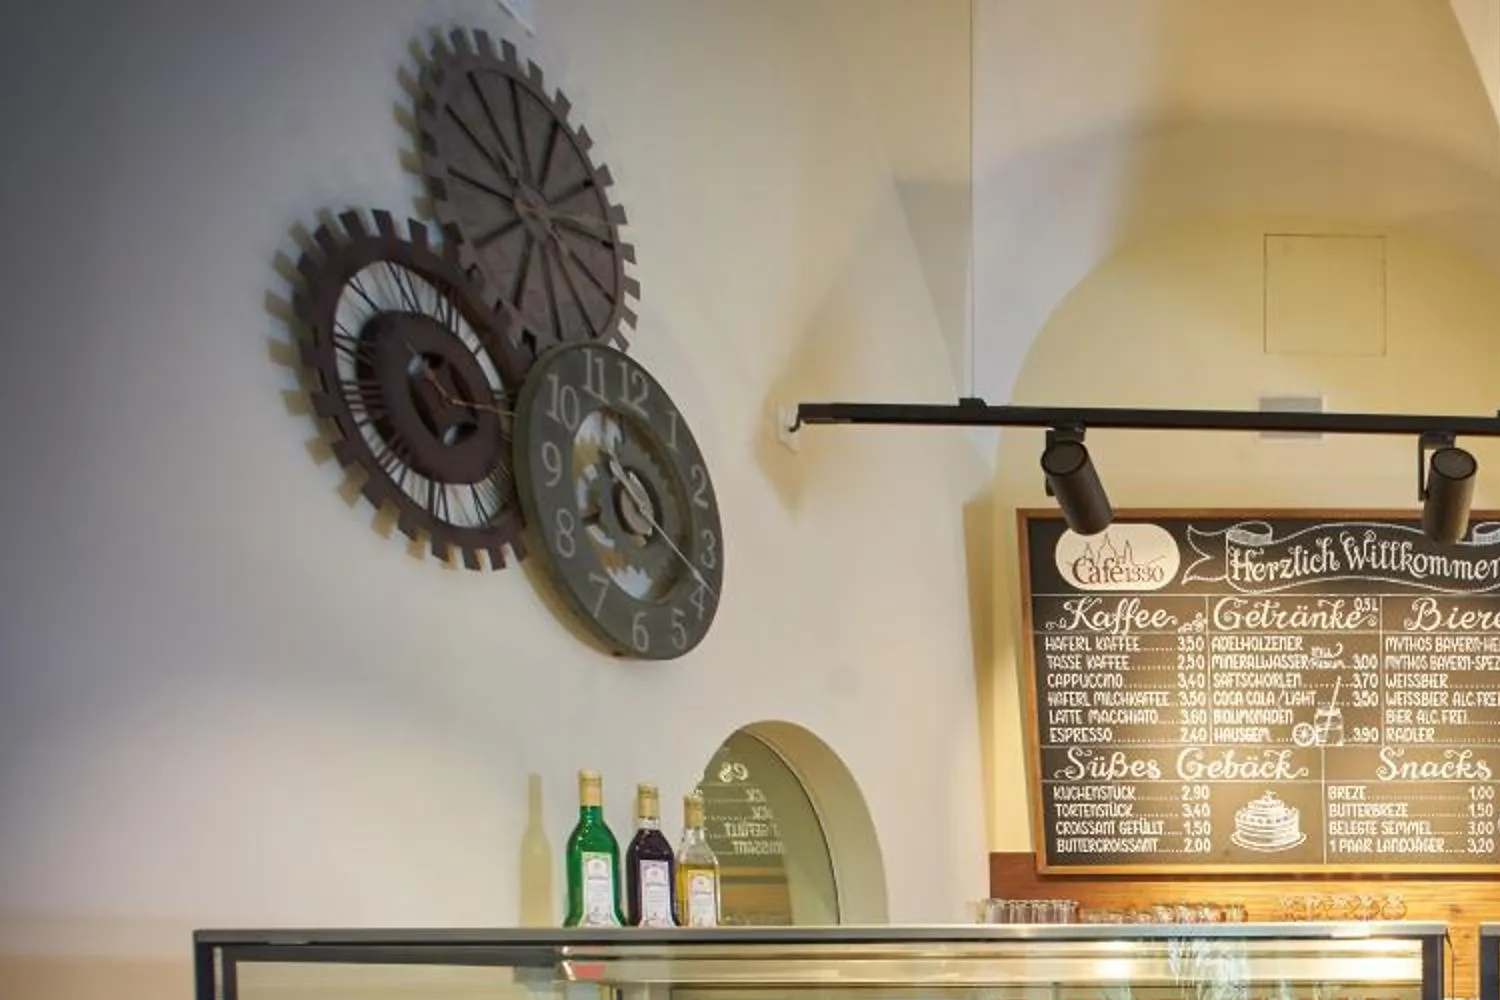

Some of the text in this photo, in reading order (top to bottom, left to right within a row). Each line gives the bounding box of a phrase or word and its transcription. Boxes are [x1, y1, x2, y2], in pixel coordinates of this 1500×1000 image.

[583, 349, 607, 402] 11
[620, 362, 650, 417] 12
[547, 373, 580, 431] 10
[666, 409, 679, 450] 1
[542, 441, 562, 487] 9
[691, 464, 709, 510] 2
[557, 508, 575, 558] 8
[702, 529, 717, 569] 3
[1229, 536, 1341, 582] Herzlich
[589, 571, 609, 619] 7
[1062, 596, 1178, 635] Kaffee
[1213, 597, 1378, 630] Getränke
[631, 611, 650, 651] 6
[671, 607, 688, 650] 5
[1045, 636, 1205, 652] HAFERL KAFFEE 3,50
[1211, 636, 1303, 651] ADELHOLZENER
[1385, 636, 1433, 652] MYTHOS
[1046, 654, 1205, 671] TASSE KAFFEE 2,50
[1212, 654, 1309, 669] MINERALWASSER
[1385, 655, 1429, 670] MYTHOS
[1047, 673, 1206, 689] CAPPUCCINO 3,40
[1213, 673, 1378, 689] SAFTSCHORLEN 3,70
[1385, 673, 1449, 689] WEISSBIER
[1048, 691, 1207, 707] HAFERL MILCHKAFFEE 3,50
[1213, 691, 1243, 706] COCA
[1386, 691, 1449, 707] WEISSBIER
[1049, 709, 1083, 725] LATTE
[1088, 709, 1159, 725] MACCHIATO
[1386, 709, 1413, 725] BIER
[1050, 727, 1113, 743] ESPRESSO
[1386, 727, 1436, 743] RADLER
[1054, 747, 1309, 781] Süßes Gebäck
[1376, 747, 1492, 780] Snacks
[1182, 785, 1210, 801] 2,90
[1328, 785, 1495, 801] BREZE 1,00
[1329, 803, 1494, 819] BUTTERBREZE 1,50
[1056, 817, 1212, 837] CROISSANT GEFÜLLT 1,50
[1329, 820, 1495, 836] BELEGTE SEMMEL 3,00
[1057, 838, 1212, 854] BUTTERCROISSANT 2,00
[1339, 838, 1373, 853] PAAR
[1467, 838, 1495, 854] 3,20
